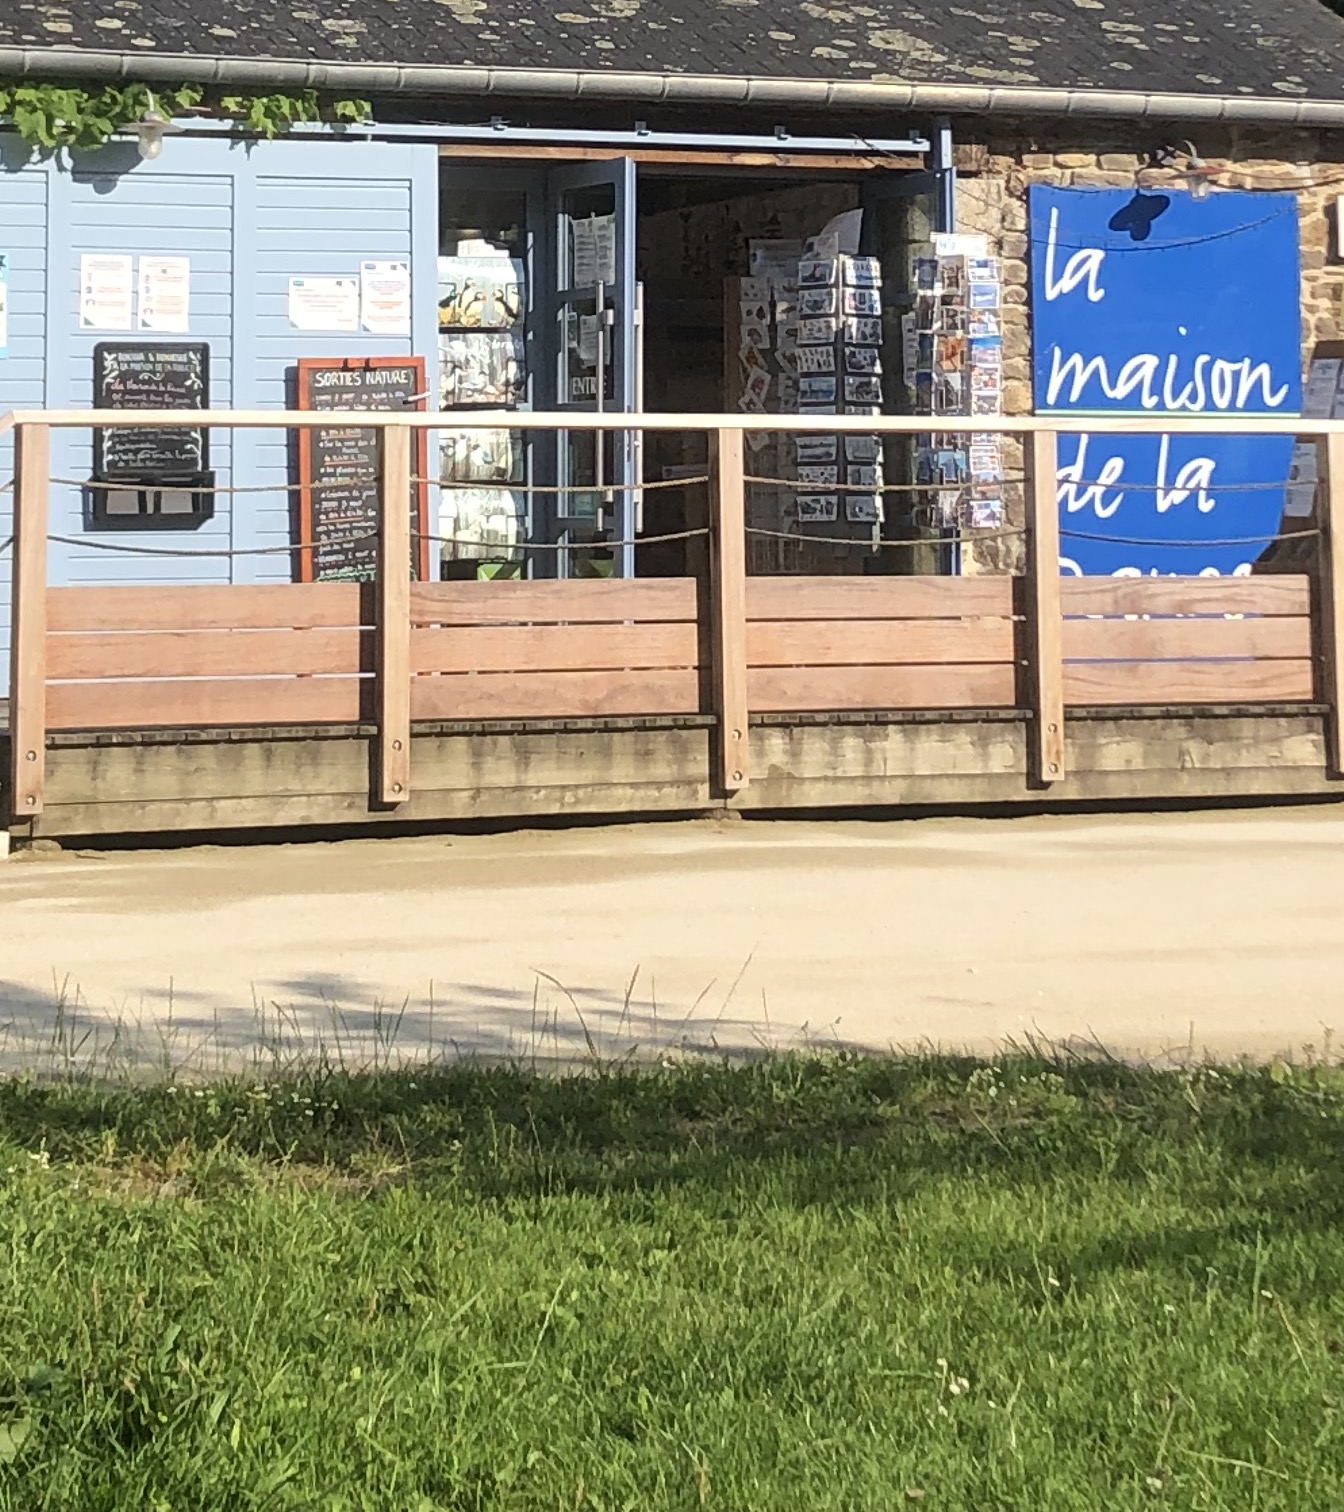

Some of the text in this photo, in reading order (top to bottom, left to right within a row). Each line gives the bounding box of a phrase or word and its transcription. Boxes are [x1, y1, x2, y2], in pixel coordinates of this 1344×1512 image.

[1045, 206, 1105, 302] la
[314, 370, 408, 387] SORTIES NATURE
[1046, 326, 1289, 412] maison
[1056, 433, 1125, 518] de
[1156, 433, 1216, 513] la
